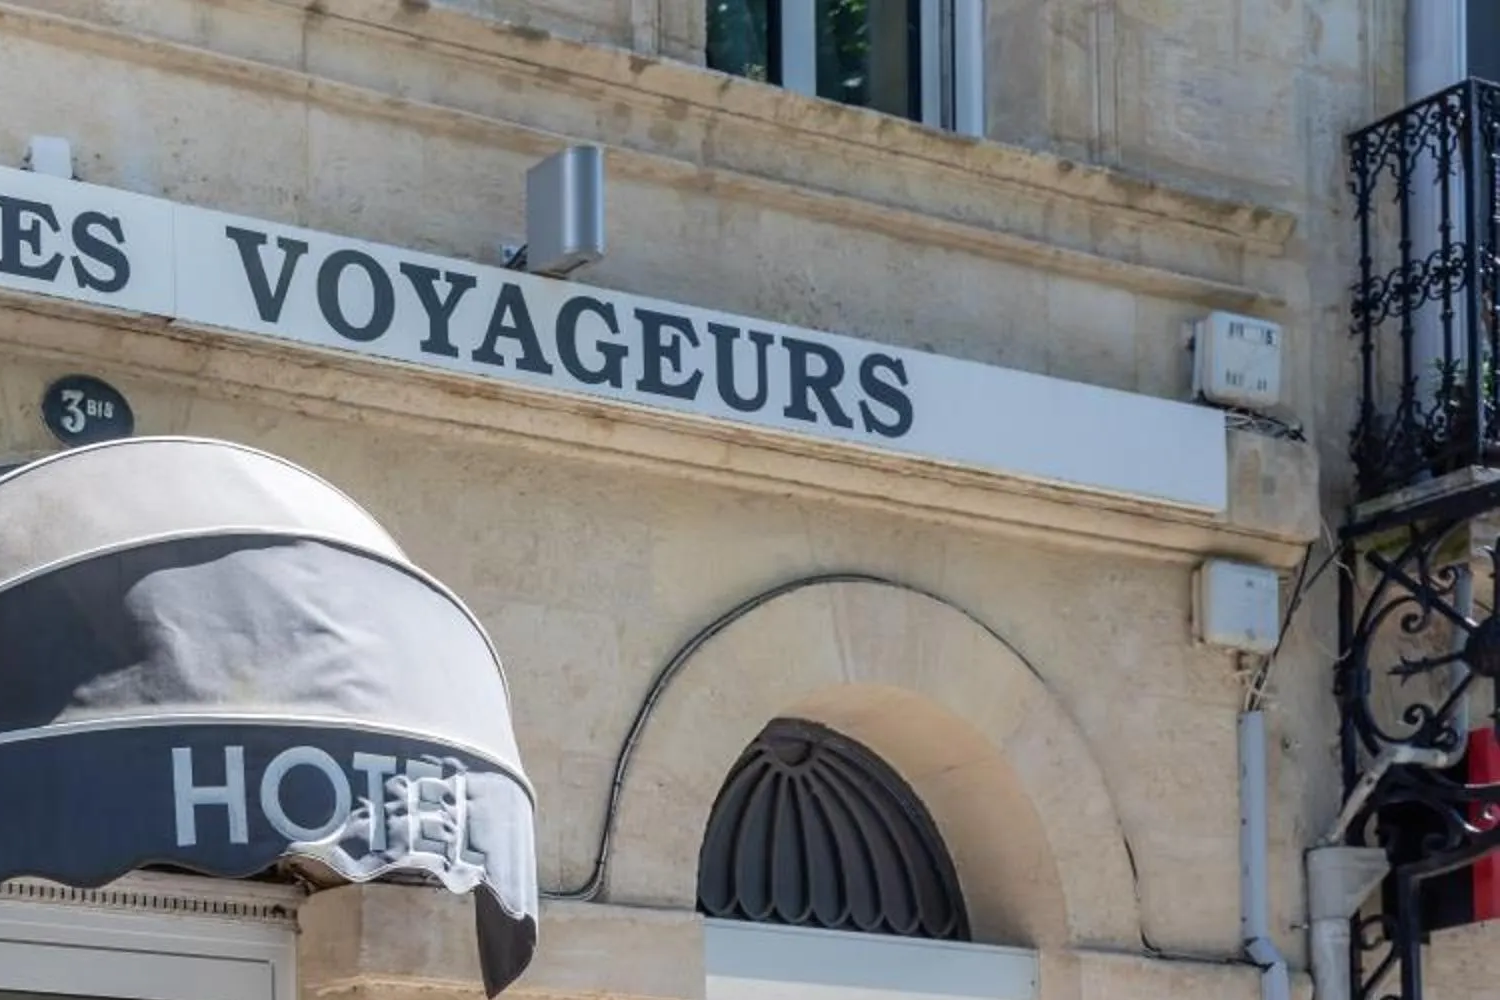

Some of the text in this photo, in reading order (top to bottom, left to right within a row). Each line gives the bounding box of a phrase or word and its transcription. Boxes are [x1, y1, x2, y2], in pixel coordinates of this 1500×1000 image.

[226, 225, 914, 438] VOYAGEURS
[61, 389, 86, 433] 3
[172, 744, 486, 866] HOTEL
